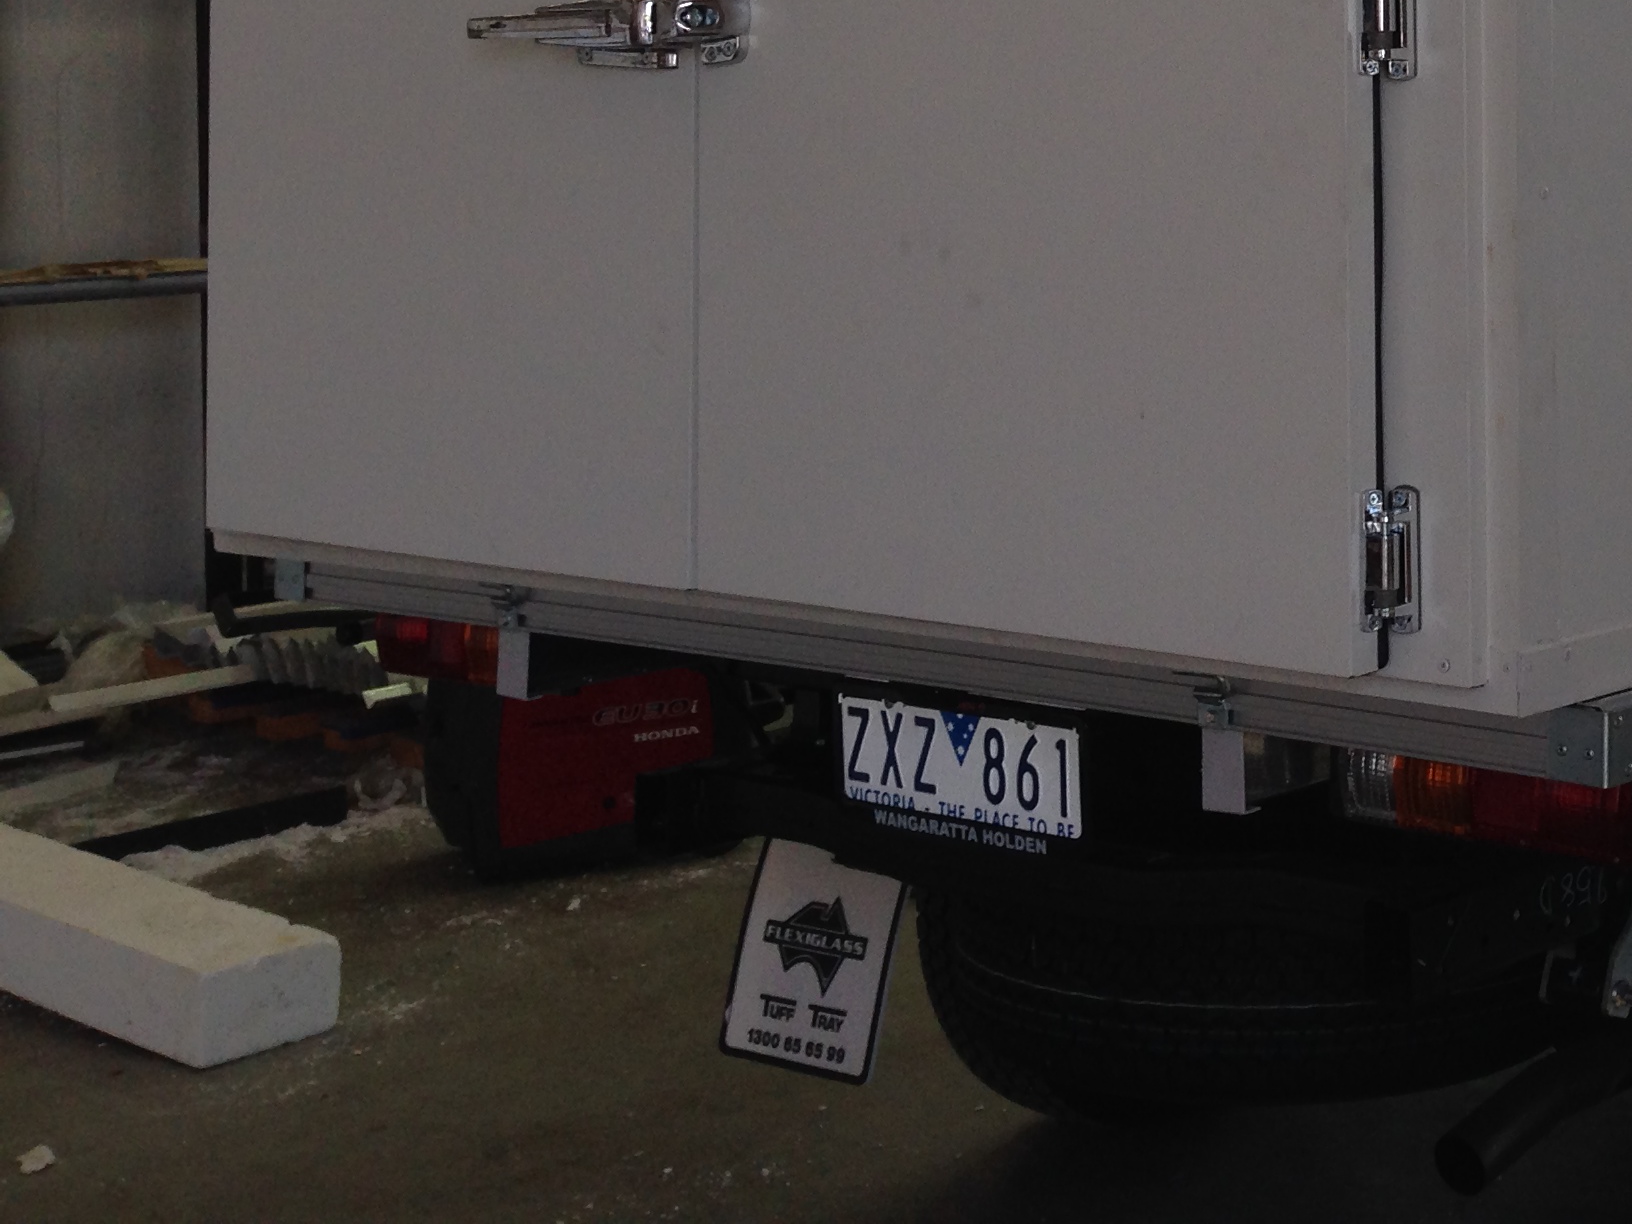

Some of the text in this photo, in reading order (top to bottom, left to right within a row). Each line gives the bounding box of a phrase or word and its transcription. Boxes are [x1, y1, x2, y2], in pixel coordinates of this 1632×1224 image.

[633, 726, 700, 743] HONDA
[847, 706, 1067, 818] ZXZ 861
[849, 786, 915, 810] VICTORIA
[938, 801, 965, 818] THE
[974, 808, 1019, 829] PLACE
[1028, 817, 1047, 835] TO
[1057, 823, 1075, 838] BE
[873, 809, 1047, 855] WANGARATTA HOLDEN
[765, 925, 864, 956] FLEXIGLASS
[748, 1028, 780, 1048] 1300
[826, 1046, 845, 1064] 99
